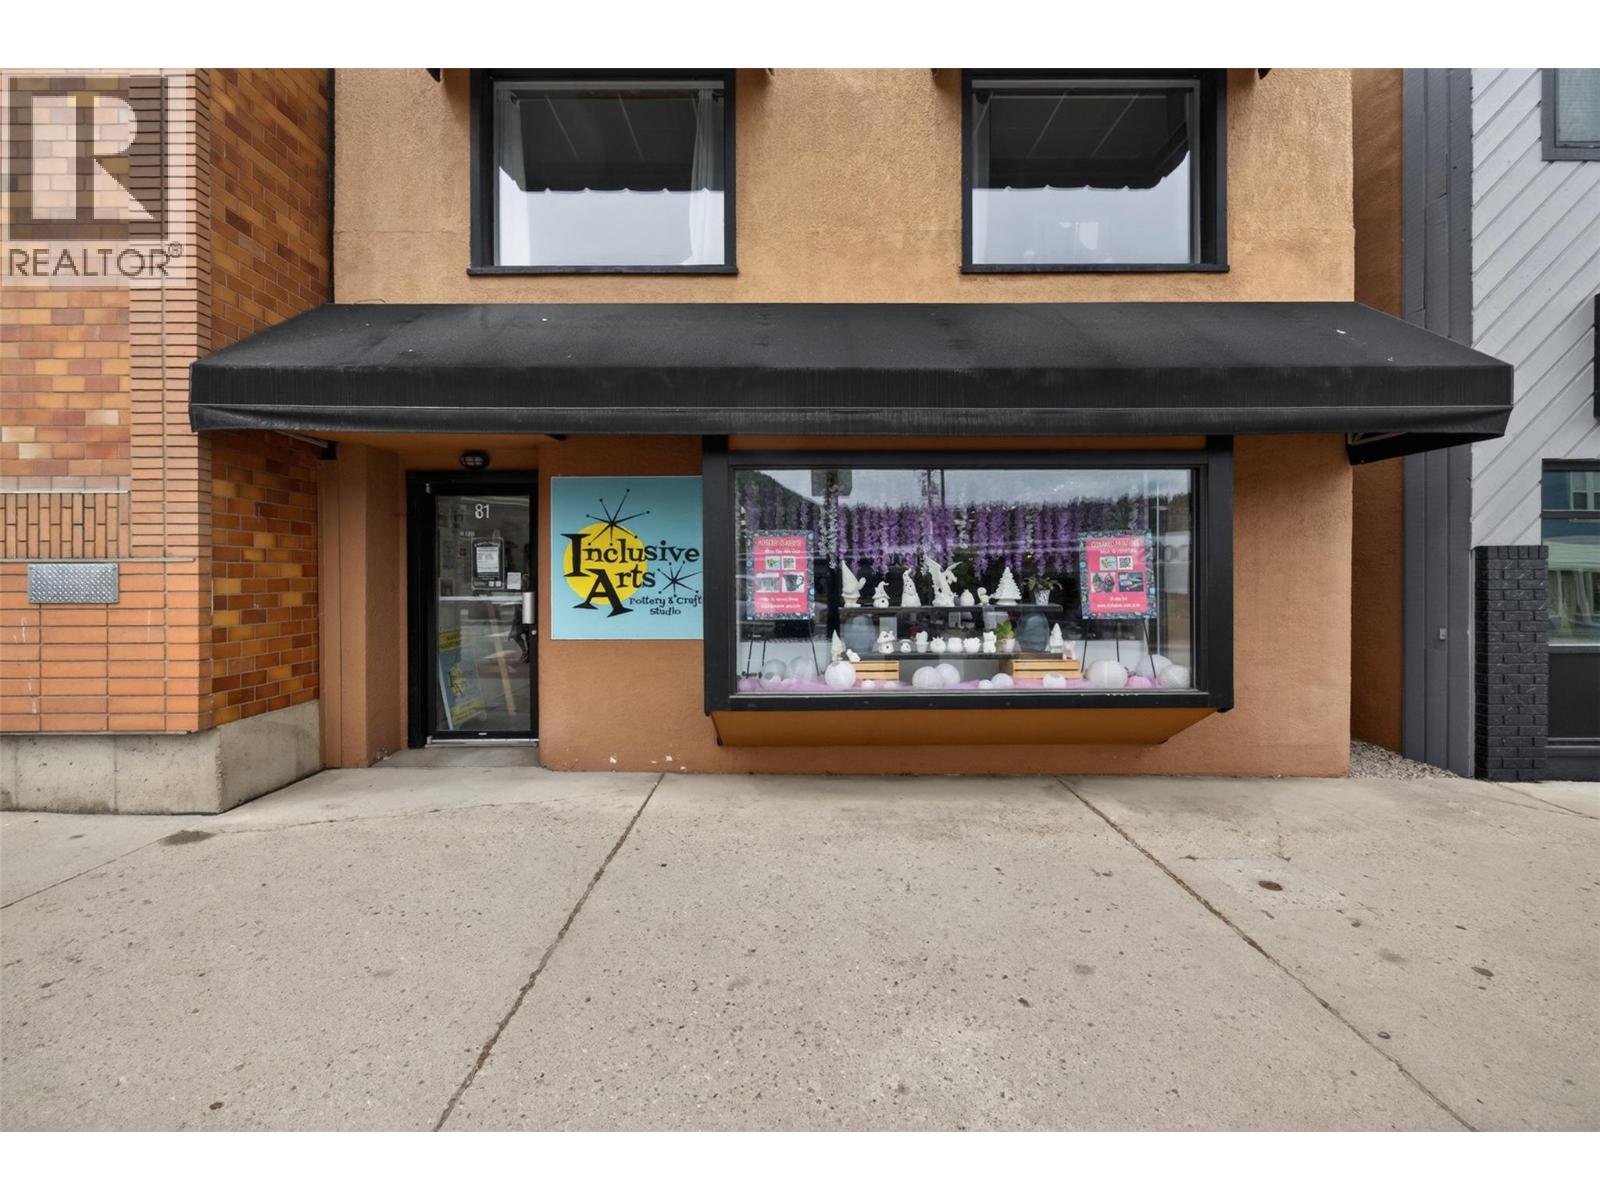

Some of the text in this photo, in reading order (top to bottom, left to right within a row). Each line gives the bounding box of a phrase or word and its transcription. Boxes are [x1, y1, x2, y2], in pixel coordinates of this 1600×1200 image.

[474, 503, 490, 519] 81
[560, 533, 700, 577] Inclusive
[572, 564, 657, 618] Arts
[629, 595, 666, 608] Pottery
[676, 594, 702, 607] Craft
[649, 606, 682, 615] Studio
